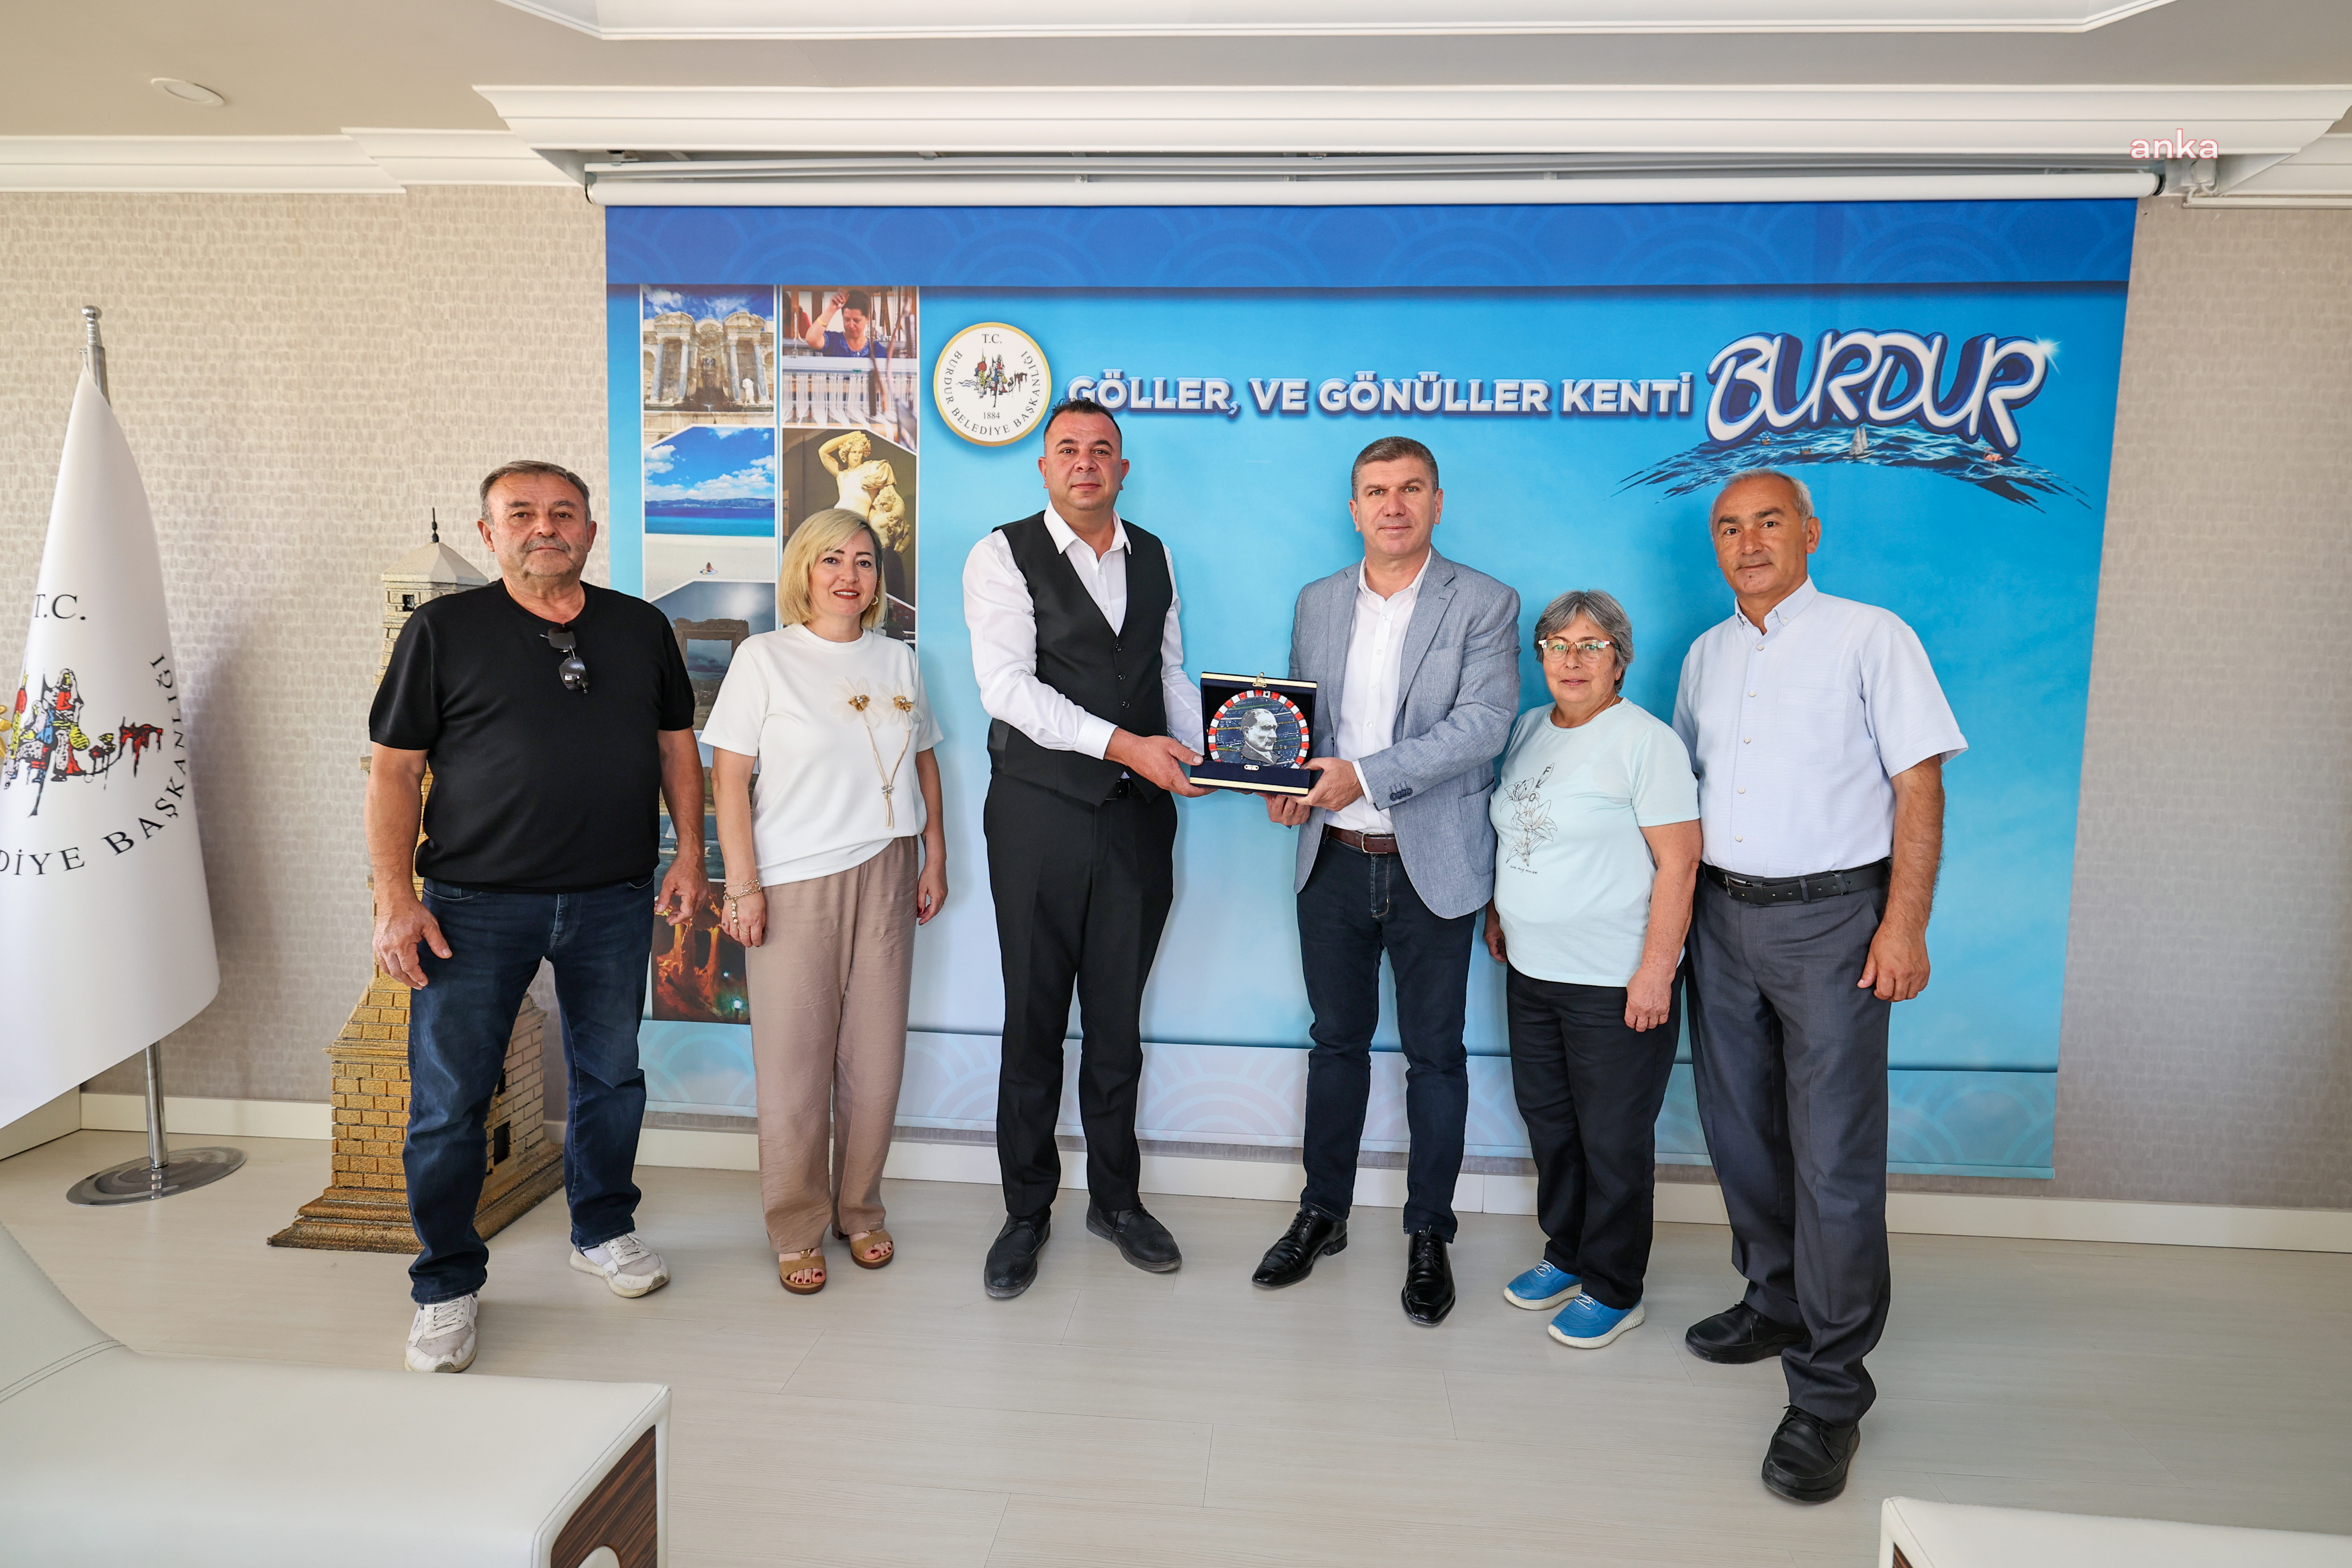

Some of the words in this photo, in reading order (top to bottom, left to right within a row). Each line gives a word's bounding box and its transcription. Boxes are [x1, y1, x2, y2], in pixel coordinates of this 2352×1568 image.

[982, 334, 1002, 343] T.C.
[944, 350, 963, 405] BURDUR
[1013, 350, 1040, 428] BAŞKANLIĞI
[1067, 370, 1240, 417] GÖLLER,
[1249, 378, 1308, 413] VE
[1318, 371, 1551, 414] GÖNÜLLER
[1561, 373, 1692, 415] KENTİ
[1706, 329, 2048, 456] BURDUR
[951, 407, 1010, 435] BELEDİYE
[34, 594, 86, 620] T.C.
